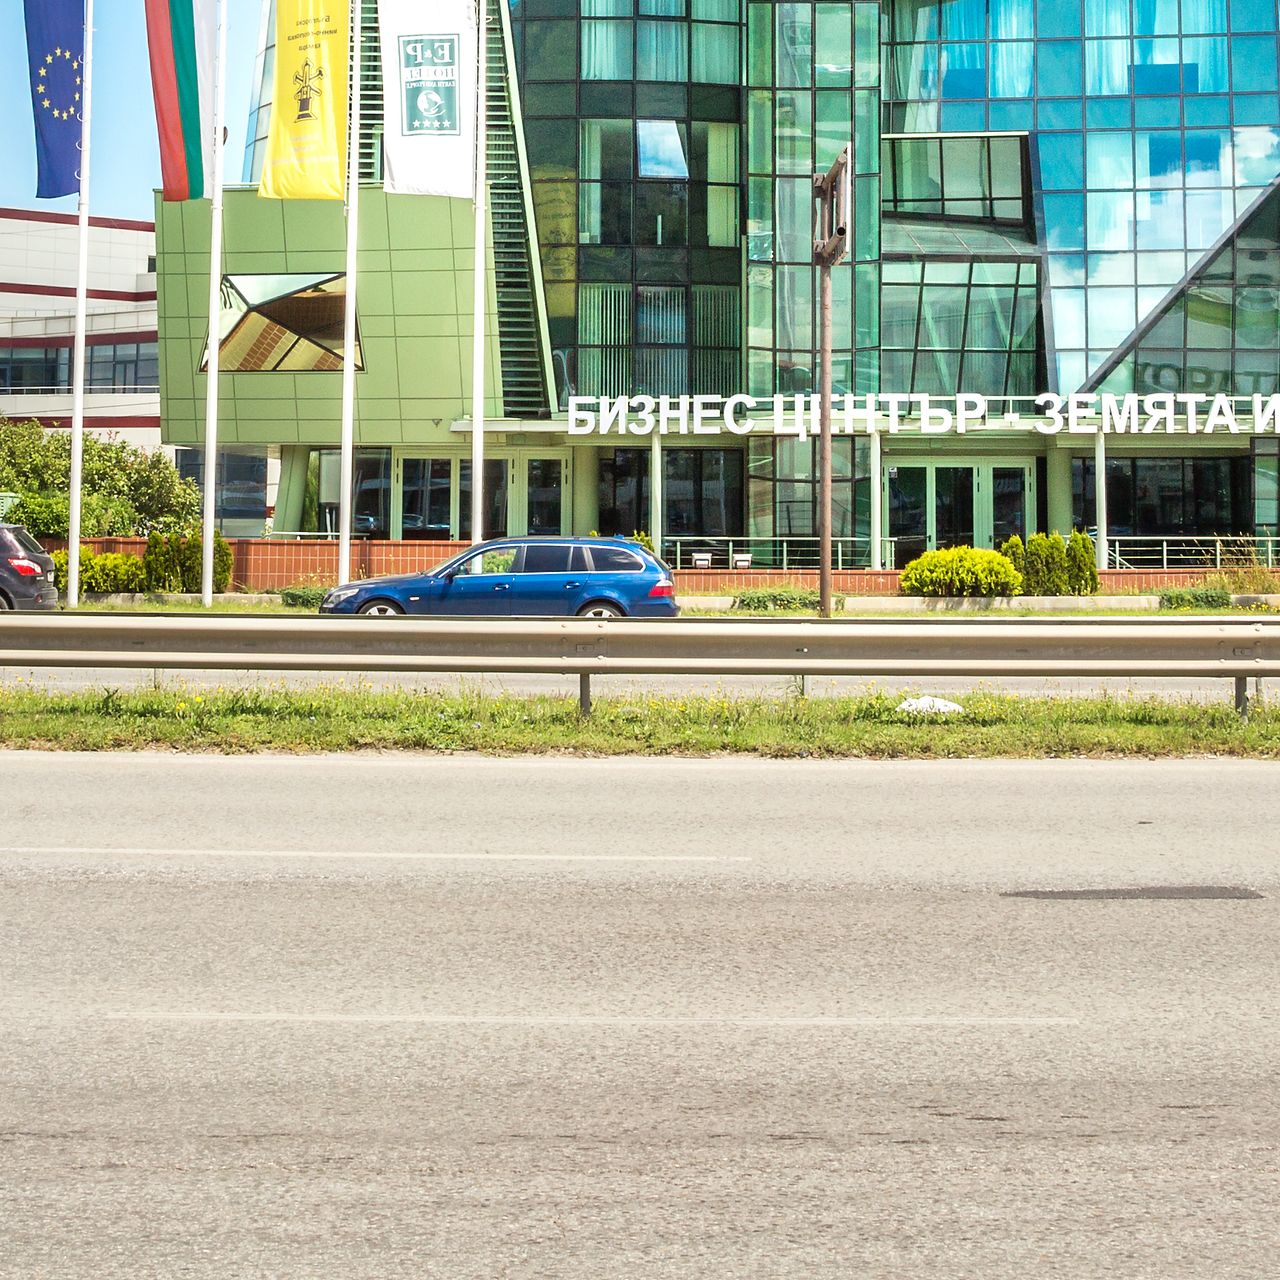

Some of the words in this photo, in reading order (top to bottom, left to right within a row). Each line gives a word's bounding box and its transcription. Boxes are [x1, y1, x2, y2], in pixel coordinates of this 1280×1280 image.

[567, 393, 757, 435] БИЗНЕС
[773, 392, 986, 442] ЦЕНТЪР
[1033, 392, 1240, 434] ЗЕМЯТА
